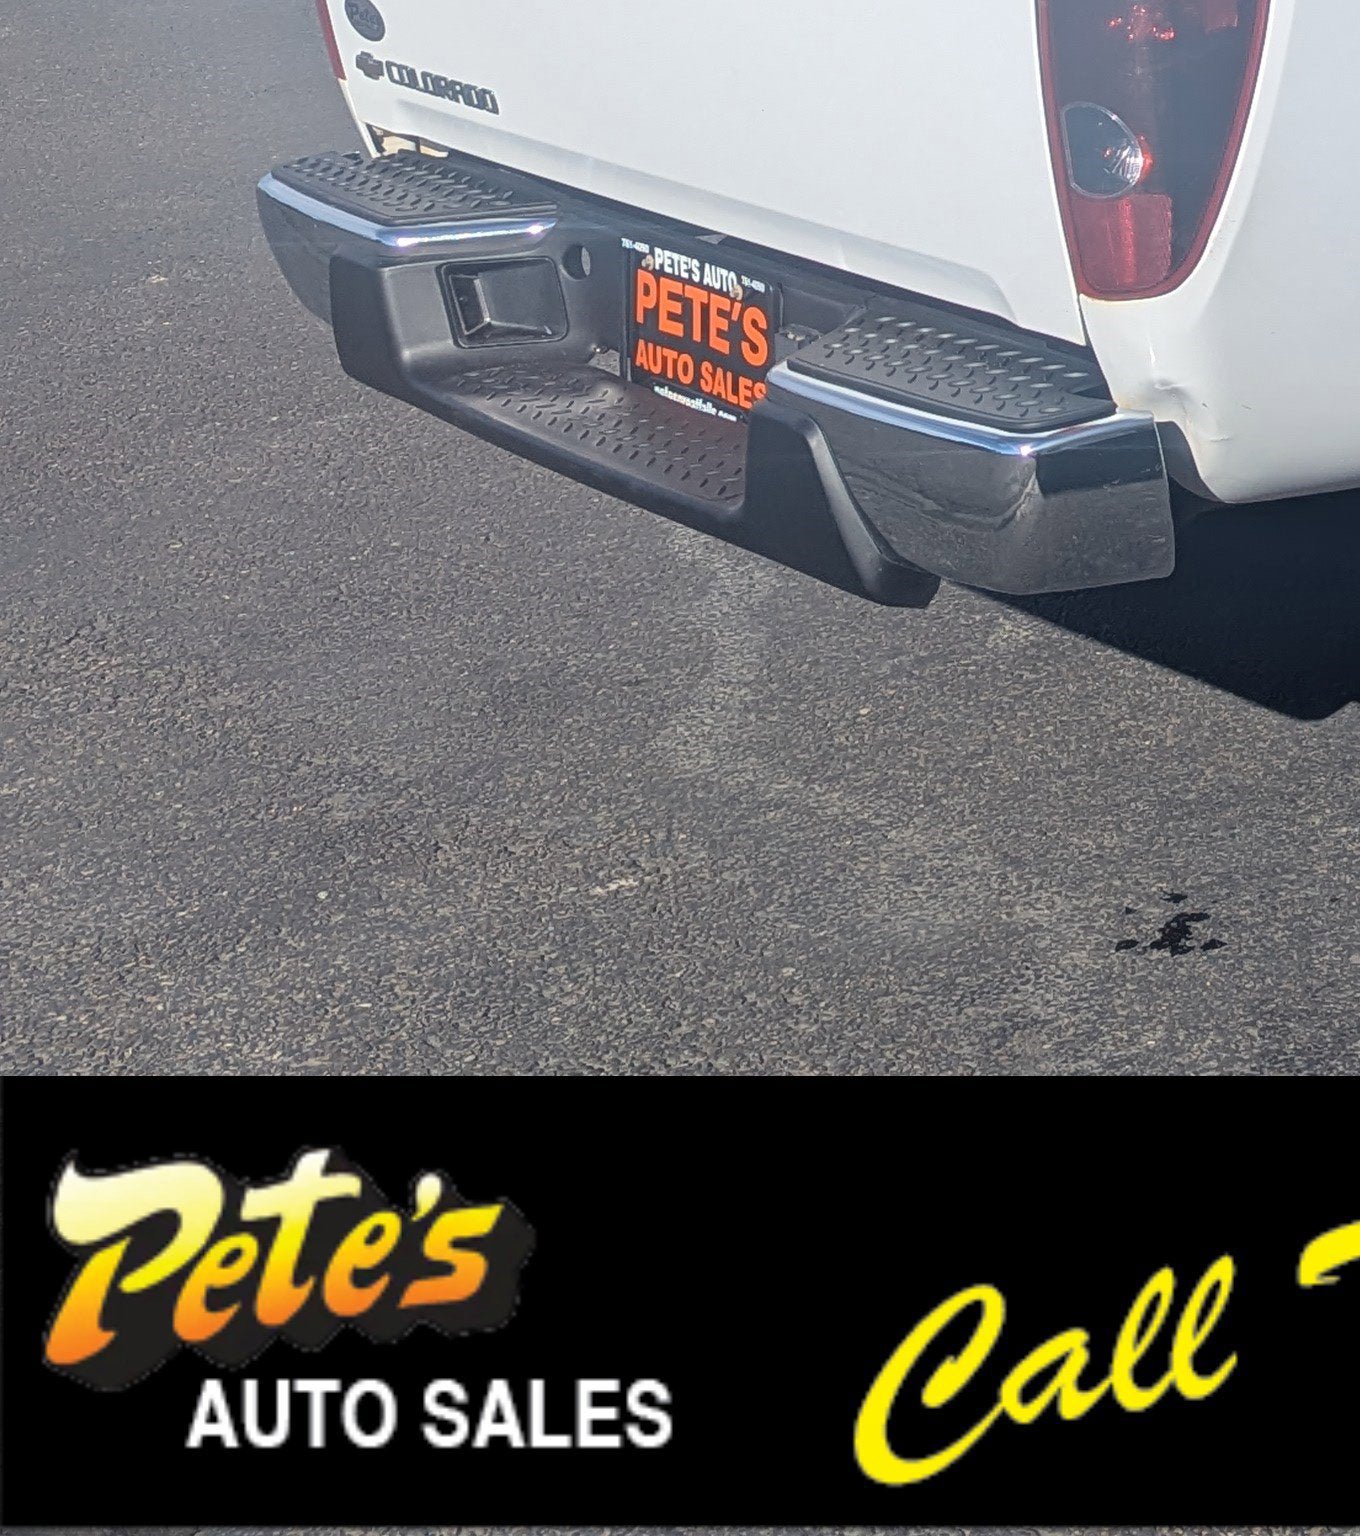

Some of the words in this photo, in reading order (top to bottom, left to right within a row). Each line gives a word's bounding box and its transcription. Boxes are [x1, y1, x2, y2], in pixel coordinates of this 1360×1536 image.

[385, 60, 500, 116] COLORADO
[653, 247, 700, 283] PETE'S
[703, 262, 738, 294] AUTO
[636, 268, 769, 367] PETE'S
[635, 338, 695, 385] AUTO
[701, 361, 767, 409] SALES
